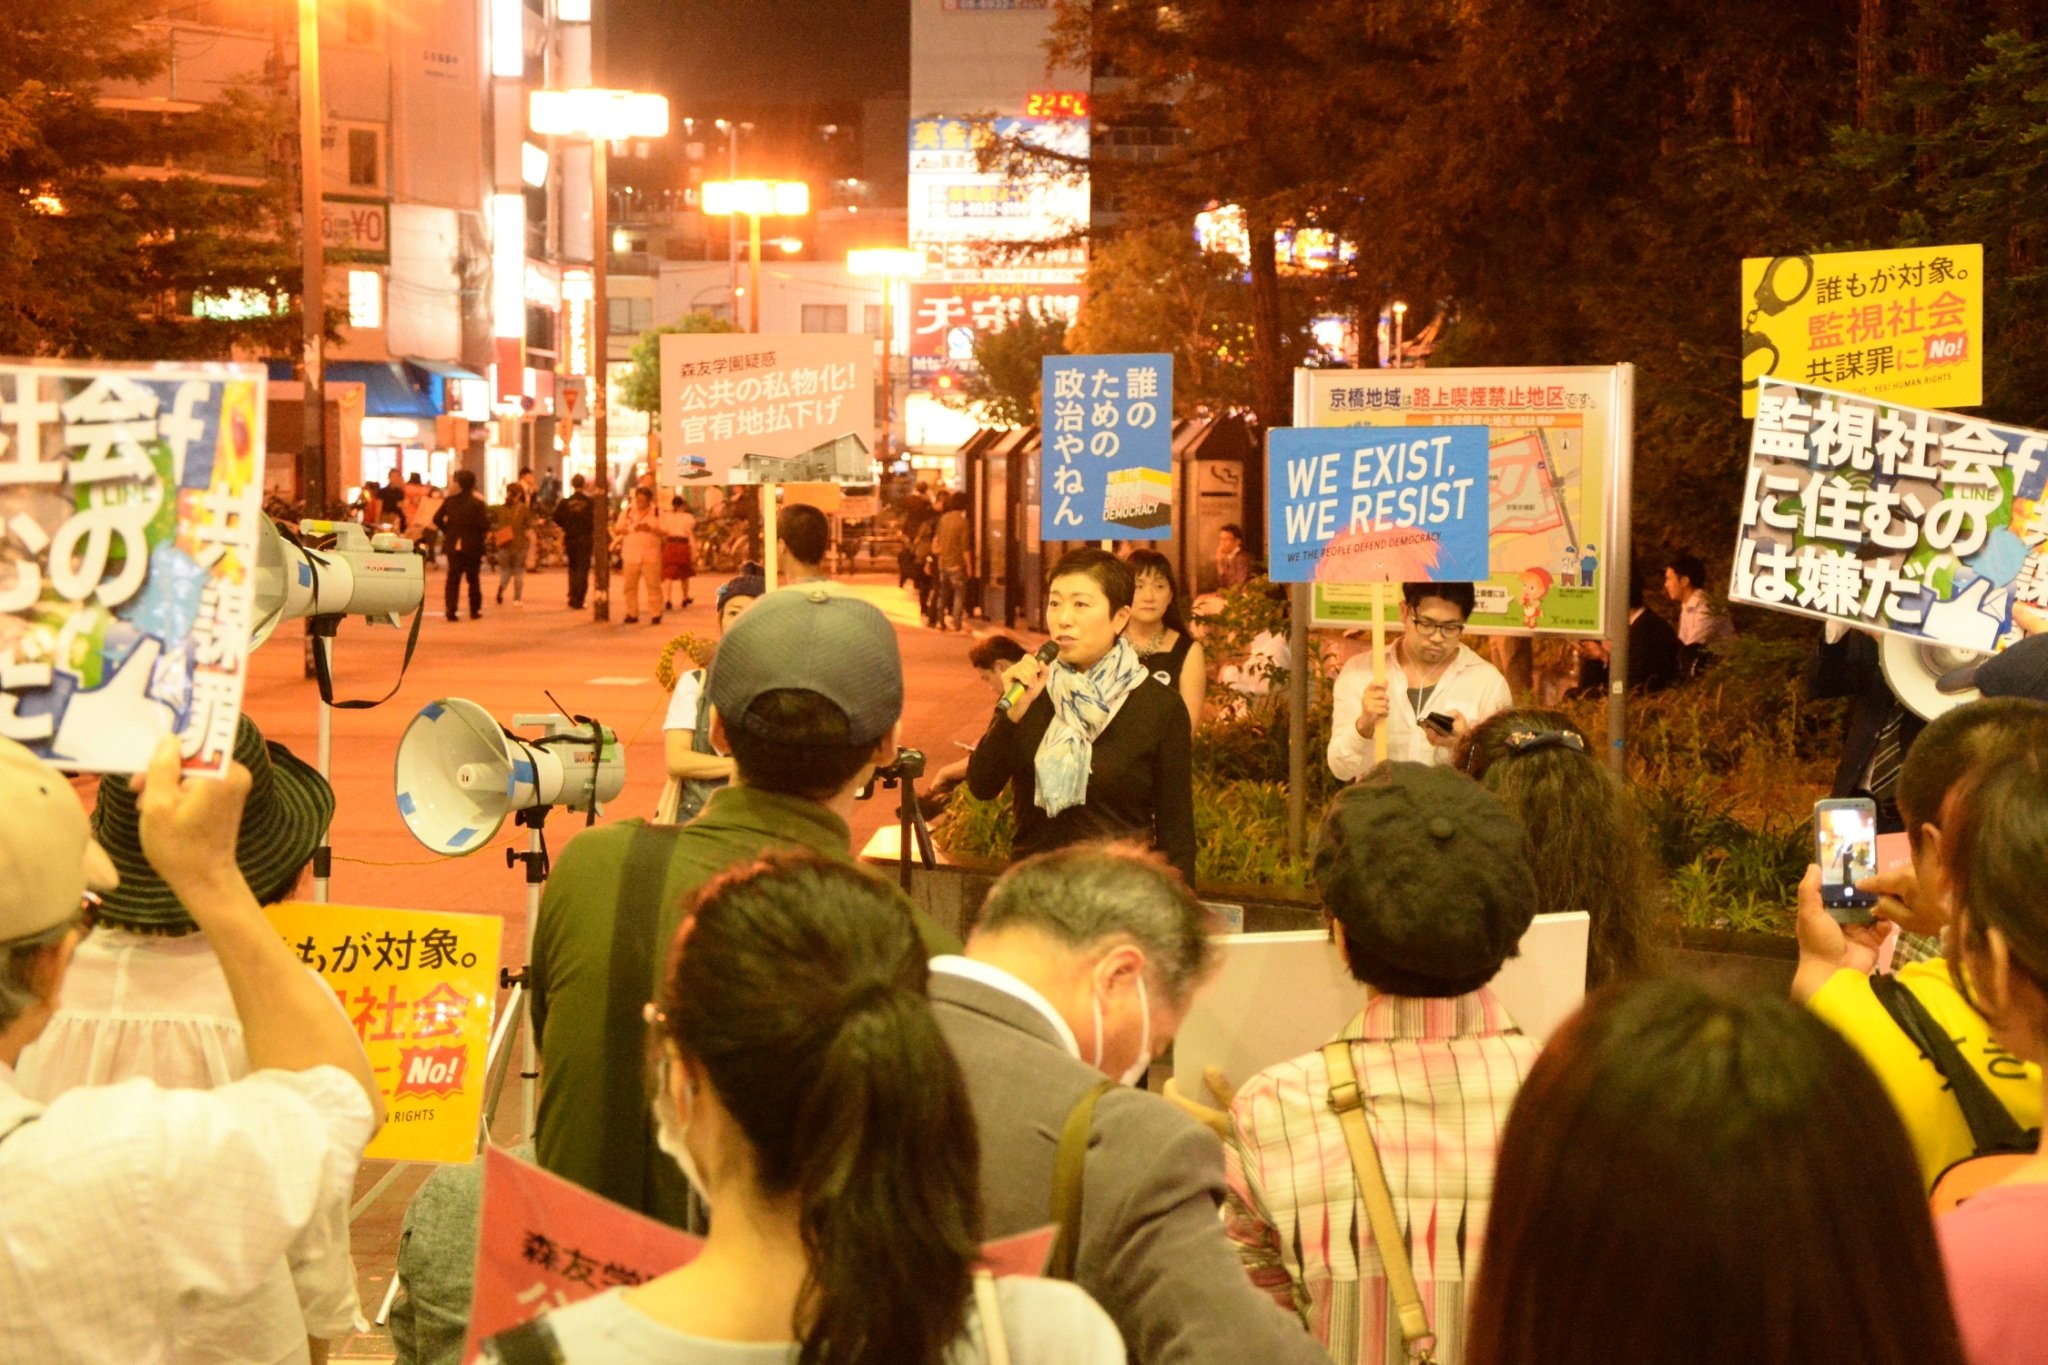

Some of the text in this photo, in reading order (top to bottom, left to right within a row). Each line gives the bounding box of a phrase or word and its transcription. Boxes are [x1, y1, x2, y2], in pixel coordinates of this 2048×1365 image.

[1816, 257, 1969, 305] 誰もが対象。
[1807, 290, 1967, 352] 監視社会
[680, 351, 777, 378] 森友学園疑惑
[1805, 337, 1964, 384] 共謀罪に No!
[1893, 377, 1922, 390] HUMAN
[1924, 373, 1952, 385] RIGHTS
[680, 362, 857, 412] 公共の私物化!
[1126, 367, 1158, 429] 誰の
[681, 394, 844, 446] 官有地払下げ
[1091, 369, 1121, 458] ための
[1053, 368, 1086, 526] 政治やねん
[1287, 435, 1456, 499] WE EXIST,
[1752, 394, 2009, 489] 監視社会
[1102, 502, 1159, 521] DEMOCRACY
[1285, 478, 1475, 545] WE RESIST
[1743, 467, 1989, 557] に住むの
[1960, 486, 1996, 502] LINE
[1287, 531, 1442, 563] WE THE PEOPLE DEFEND DEMOCRACY
[1736, 538, 1926, 625] は嫌だ
[407, 1056, 459, 1085] No!
[394, 1108, 435, 1123] RIGHTS
